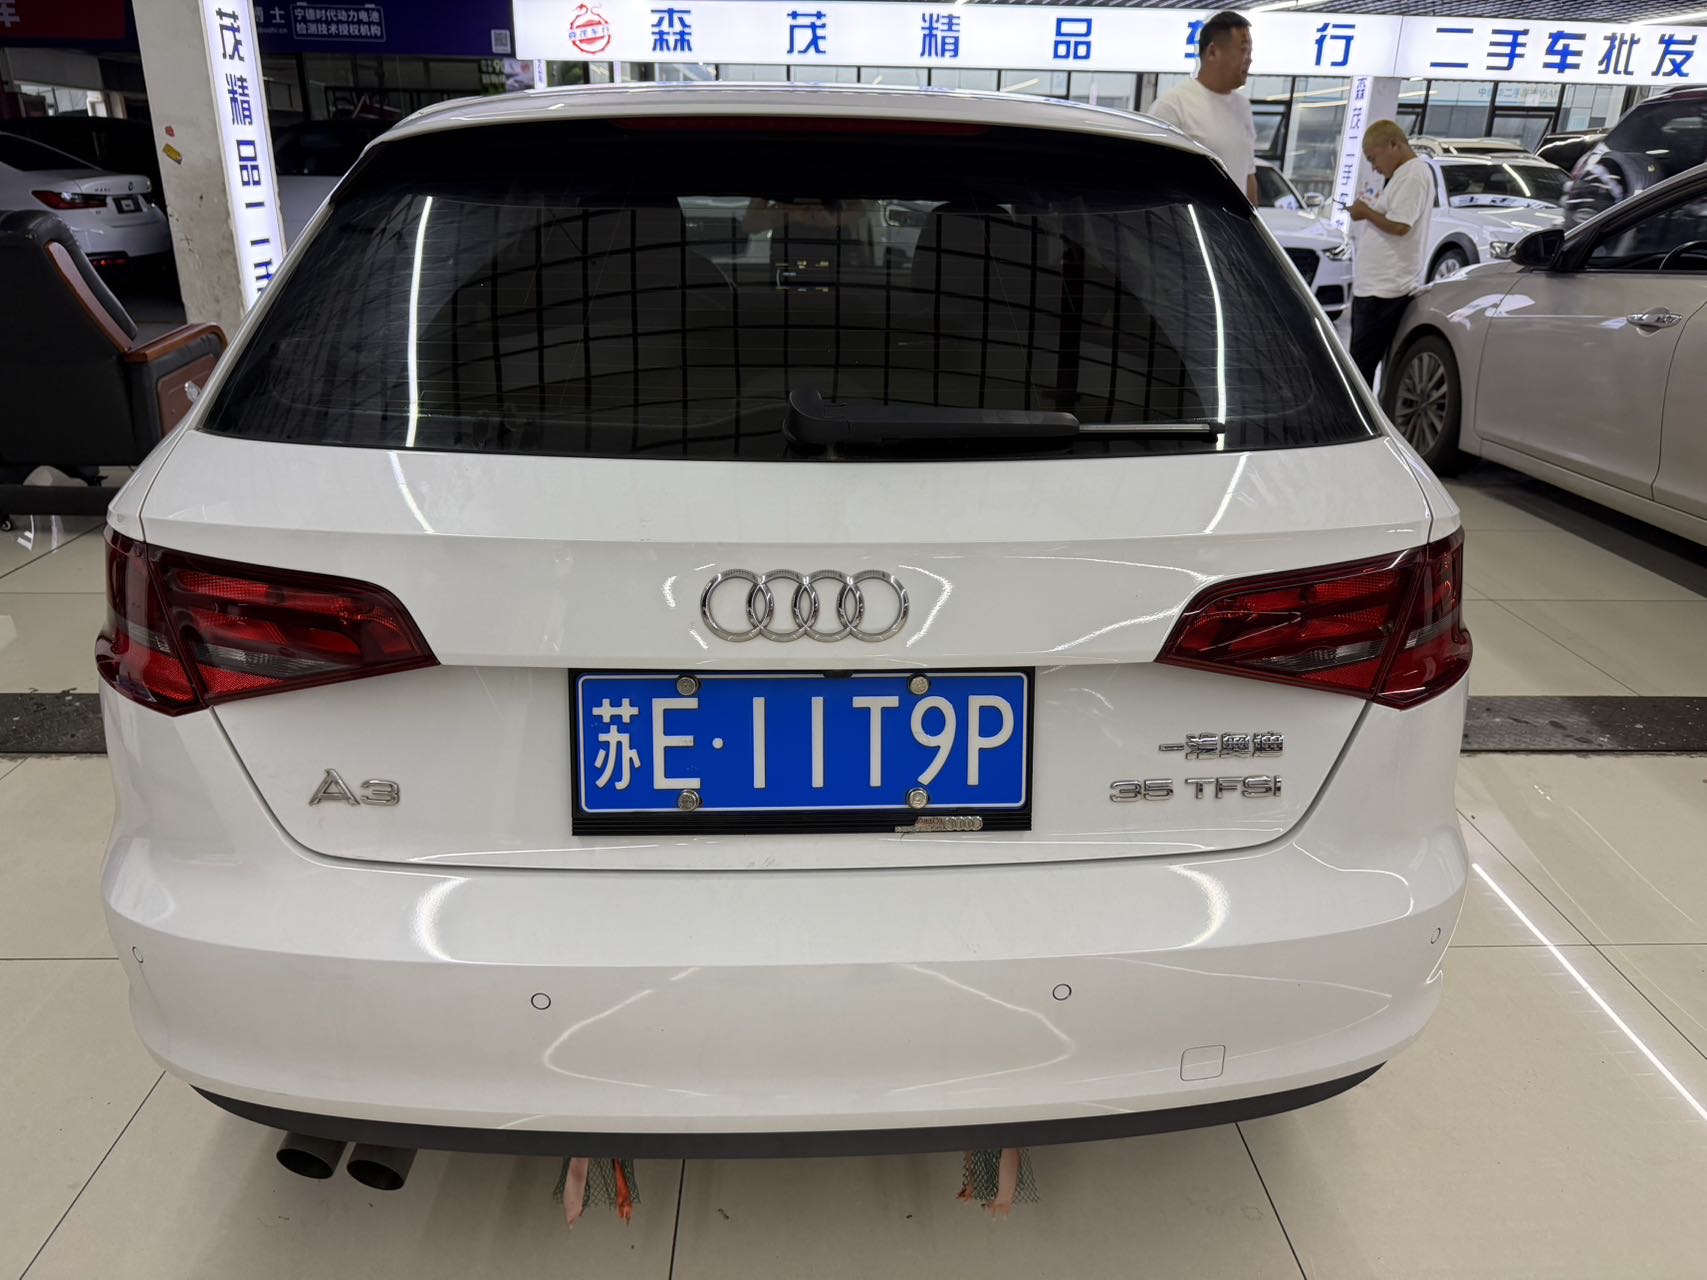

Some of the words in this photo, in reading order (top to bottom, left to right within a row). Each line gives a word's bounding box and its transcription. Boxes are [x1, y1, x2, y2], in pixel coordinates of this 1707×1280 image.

[294, 8, 380, 23] 宁德时代动力电池
[295, 22, 381, 37] 检测技术授权机构
[1430, 26, 1698, 78] 二手车批发
[308, 768, 401, 806] A3
[1109, 777, 1174, 803] 35
[1184, 774, 1282, 800] TFSI
